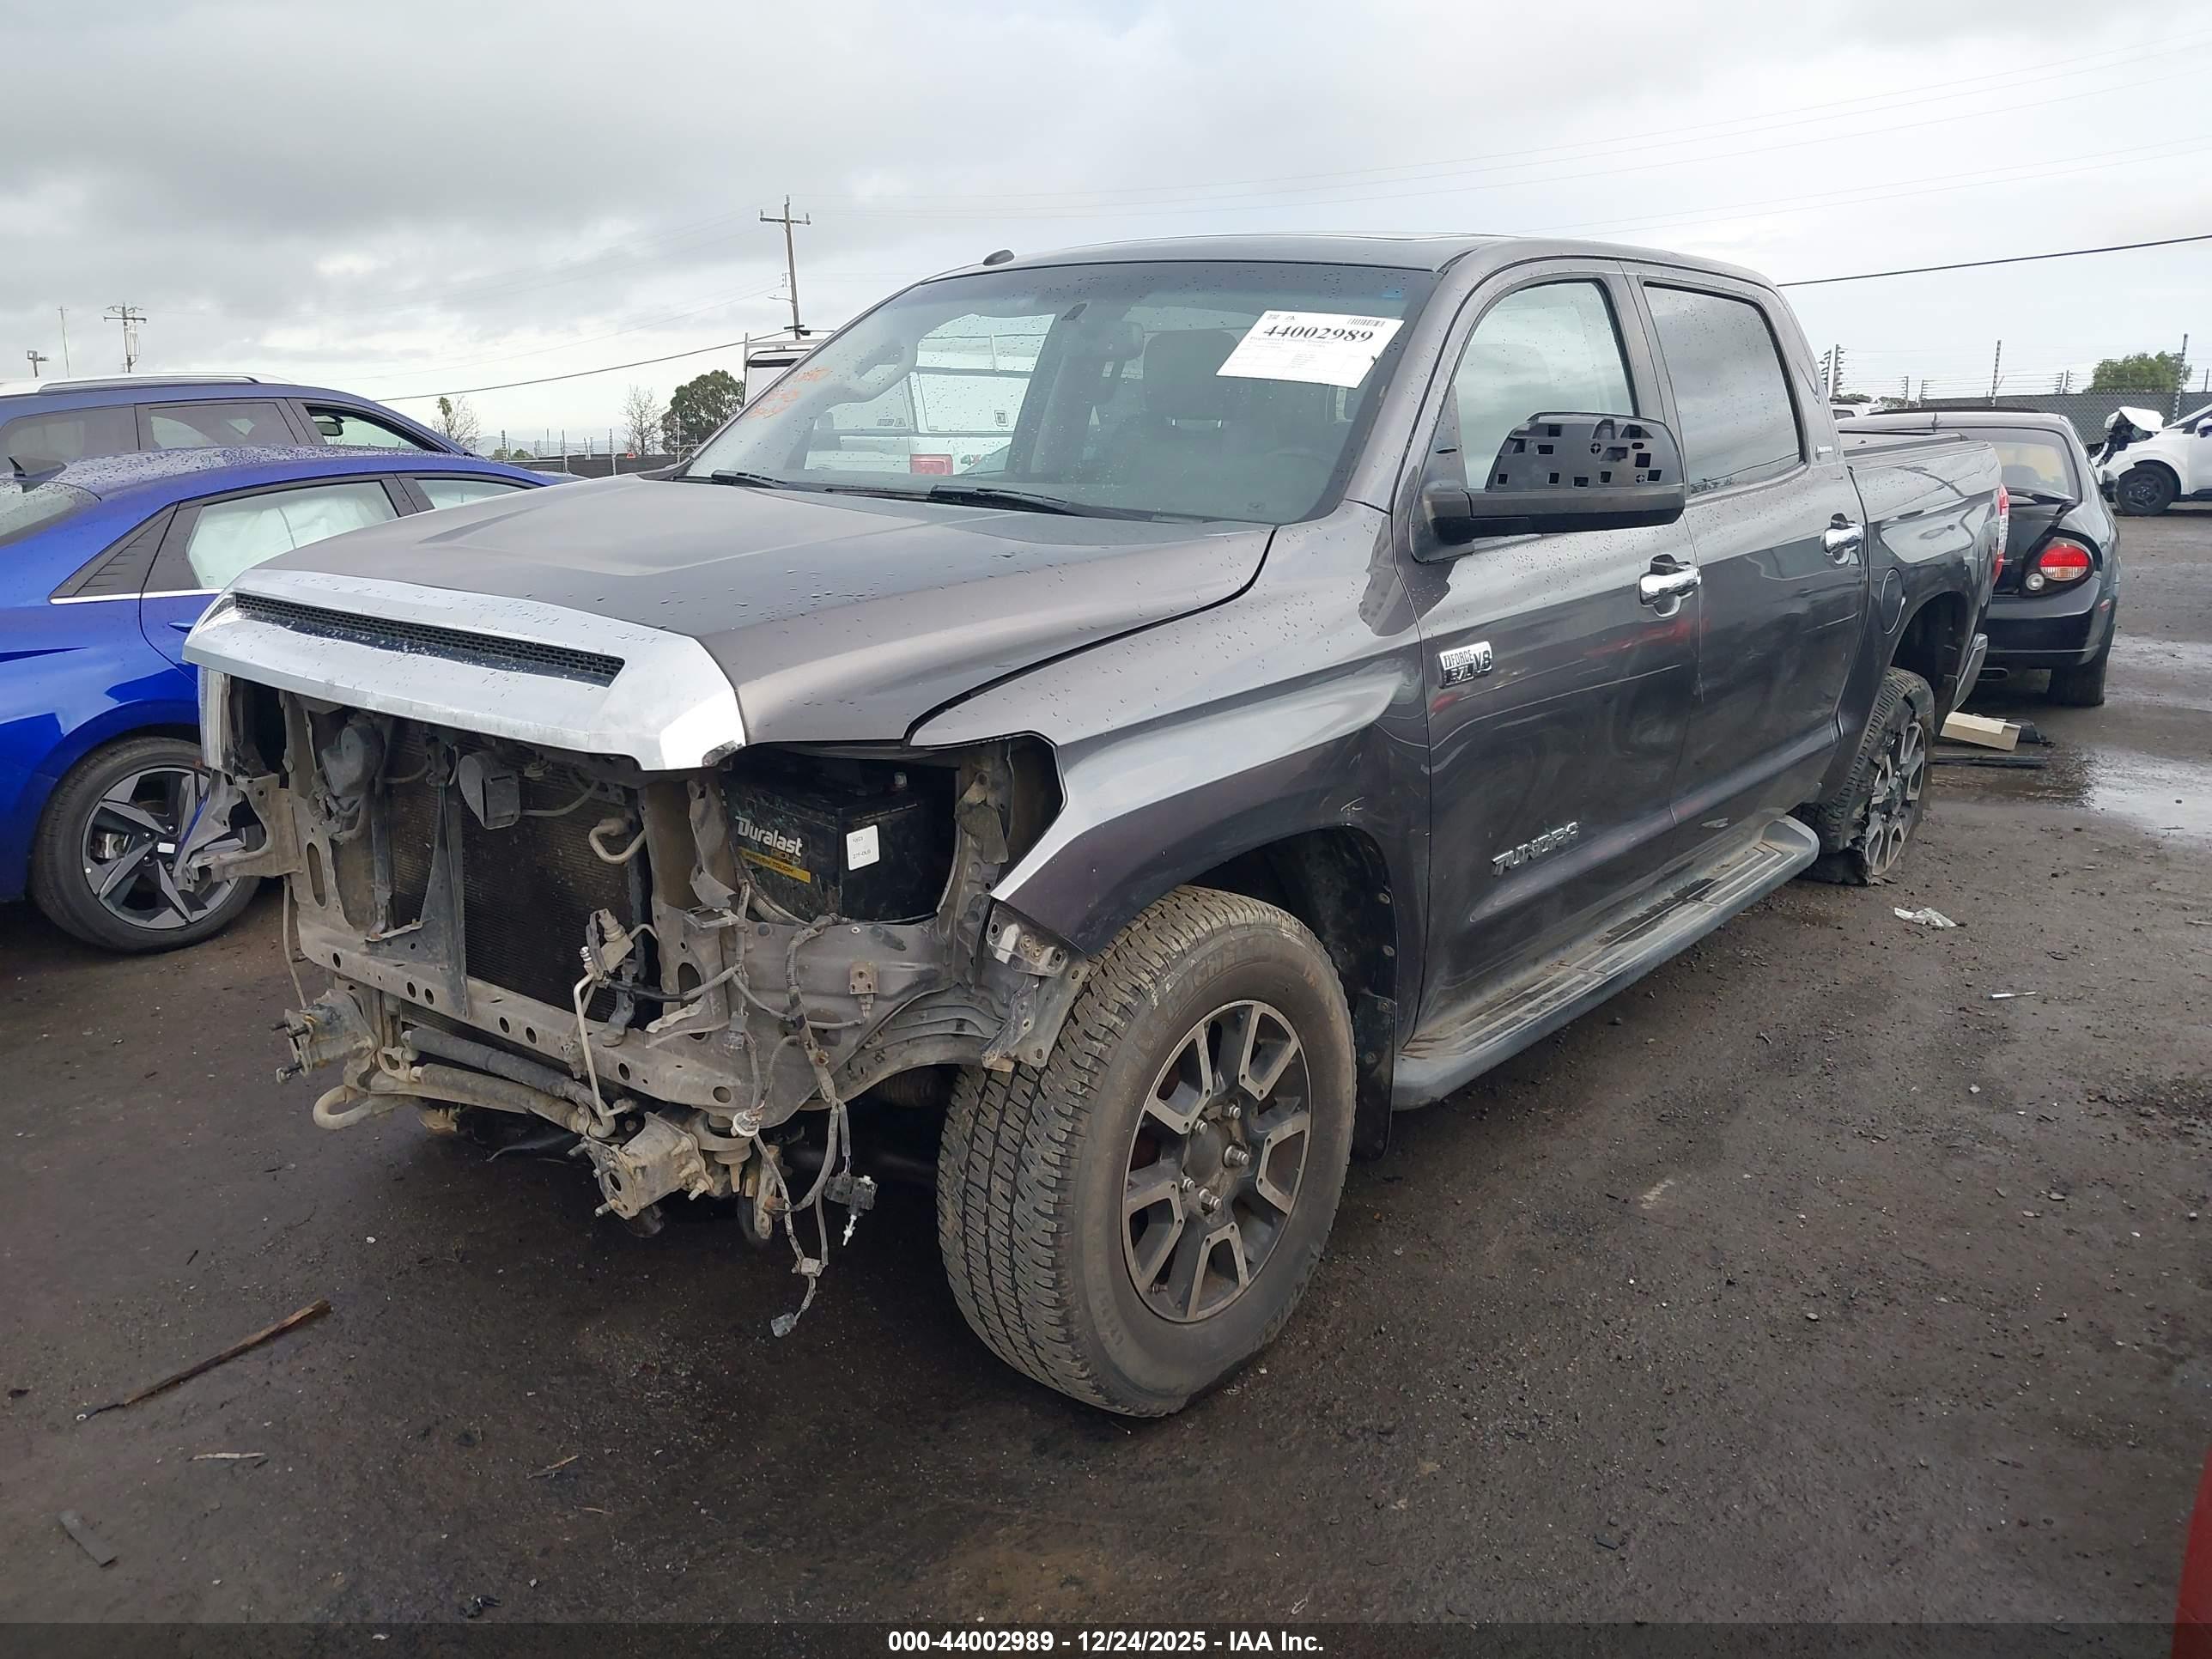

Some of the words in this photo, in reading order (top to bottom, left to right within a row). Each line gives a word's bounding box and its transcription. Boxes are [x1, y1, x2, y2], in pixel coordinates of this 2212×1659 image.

[1263, 325, 1374, 343] 44002989
[1474, 650, 1491, 671] V8
[735, 816, 804, 857] Duralast
[1492, 821, 1579, 876] TUNDRA
